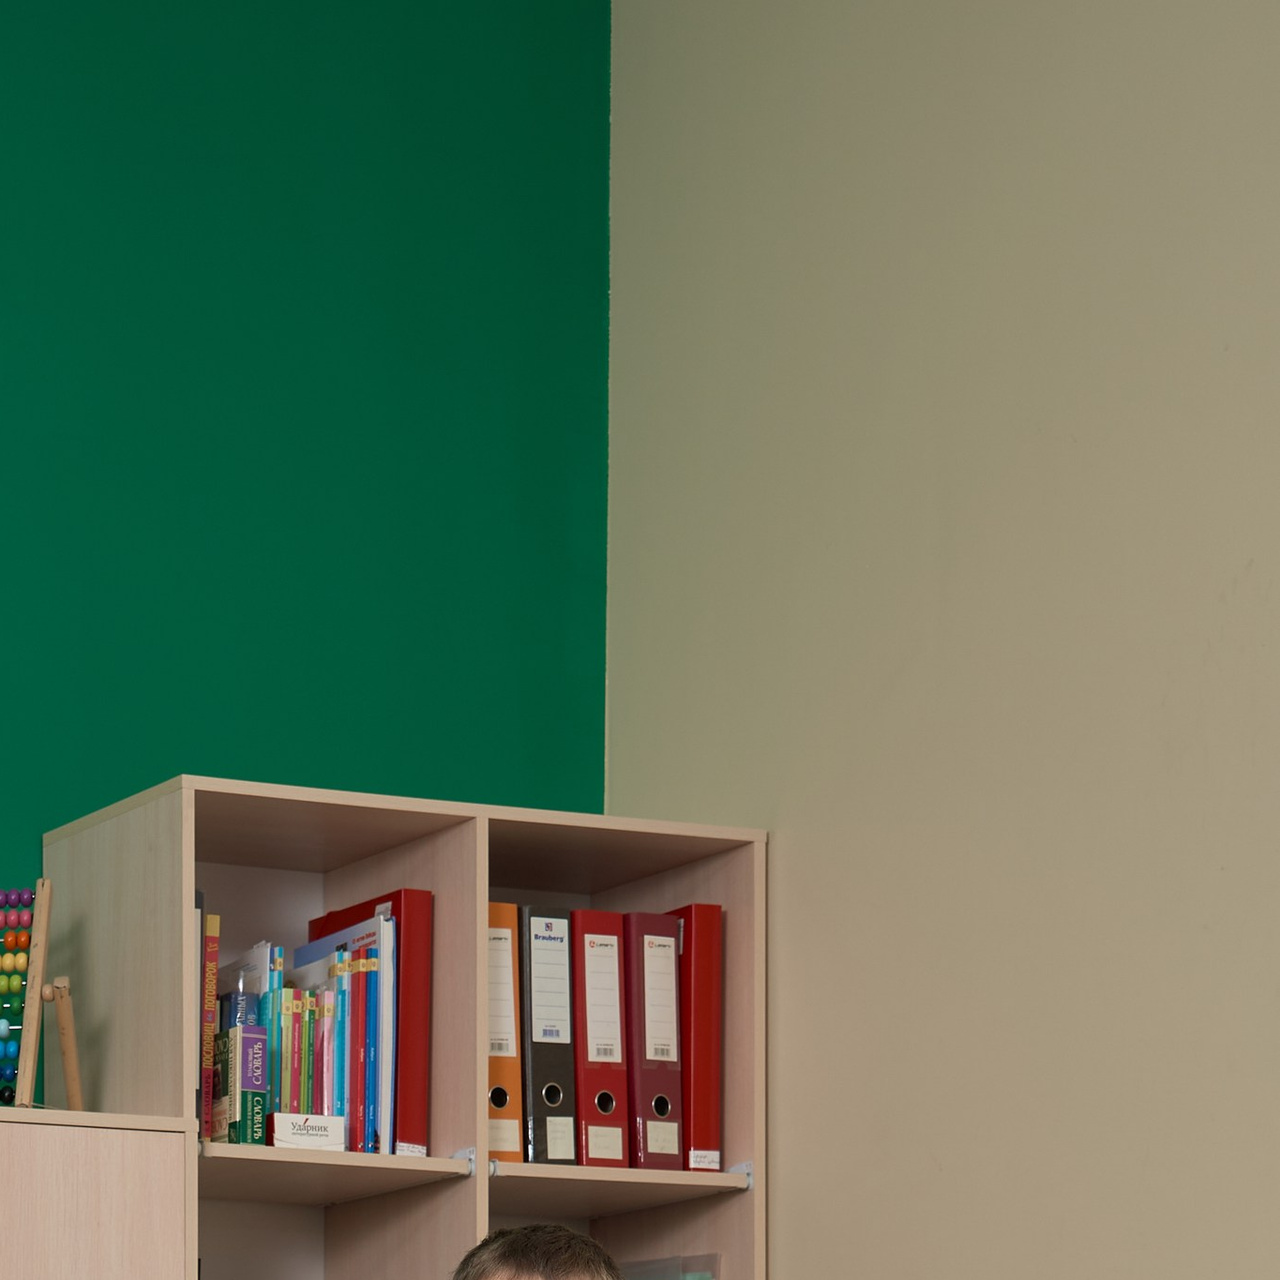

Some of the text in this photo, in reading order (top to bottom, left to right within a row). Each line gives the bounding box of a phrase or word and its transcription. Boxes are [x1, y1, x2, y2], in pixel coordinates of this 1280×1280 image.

[534, 933, 564, 943] Brauberg
[204, 961, 217, 1011] ПОГОВОРОК
[203, 1023, 215, 1069] ПОСЛОВИЦ
[253, 1042, 263, 1085] СЛОВАРЬ
[253, 1097, 263, 1140] СЛОВАРЬ
[291, 1119, 329, 1134] Ударник
